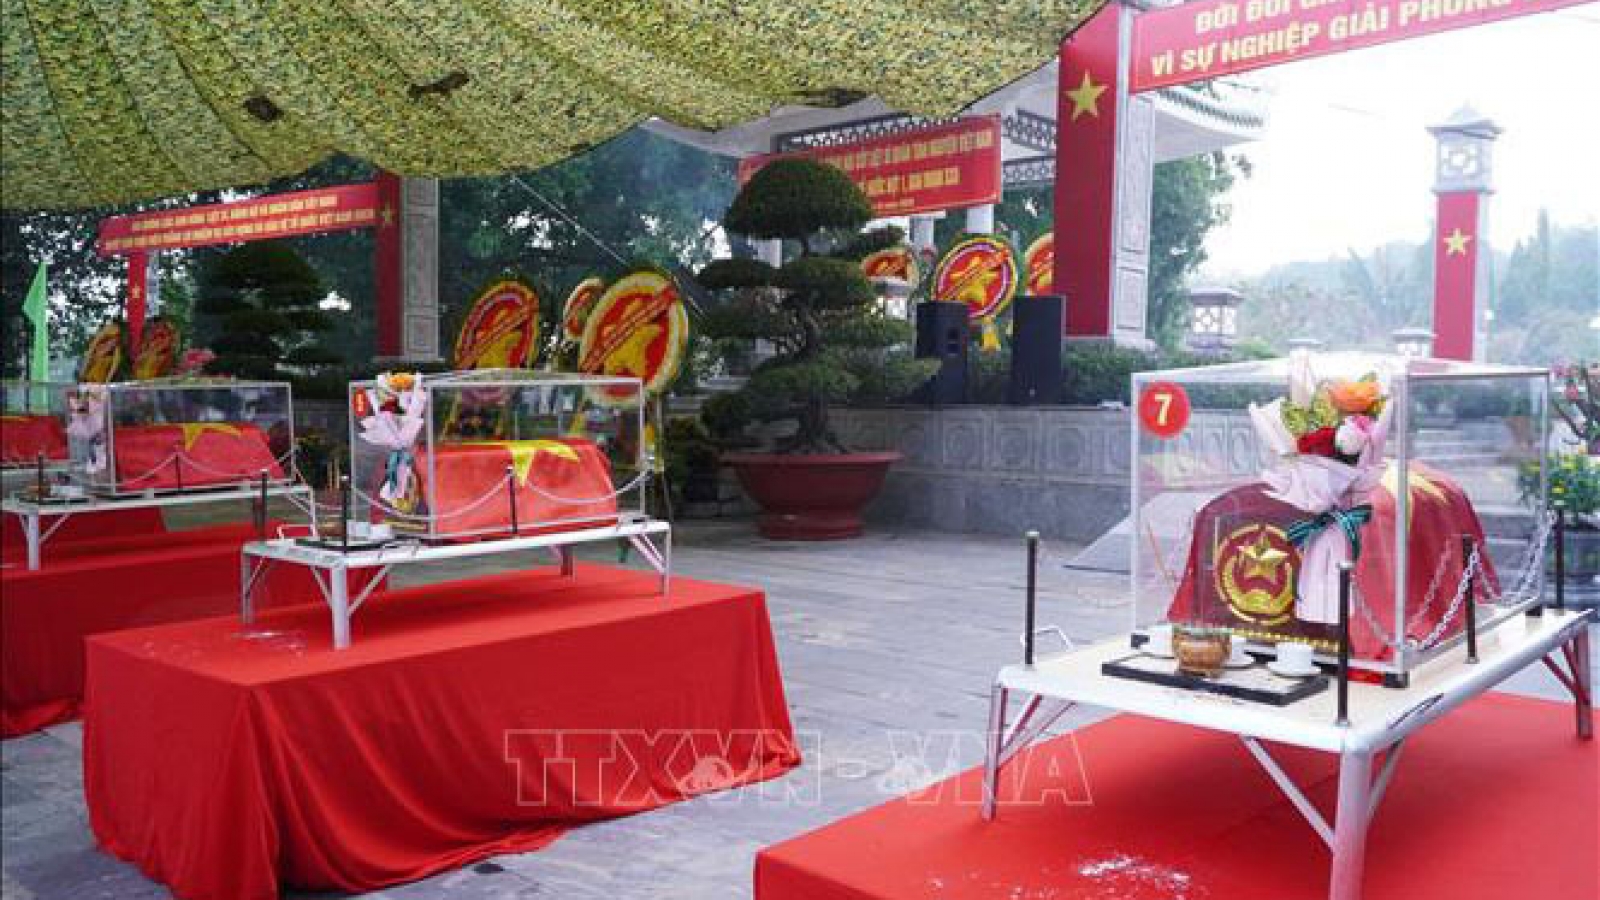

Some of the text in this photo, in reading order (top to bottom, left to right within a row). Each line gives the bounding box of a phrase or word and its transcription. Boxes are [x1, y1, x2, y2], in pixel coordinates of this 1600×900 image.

[1179, 41, 1217, 71] SỰ
[1221, 20, 1320, 63] NGHIỆP
[1328, 1, 1389, 41] GIẢI
[1154, 393, 1173, 427] 7
